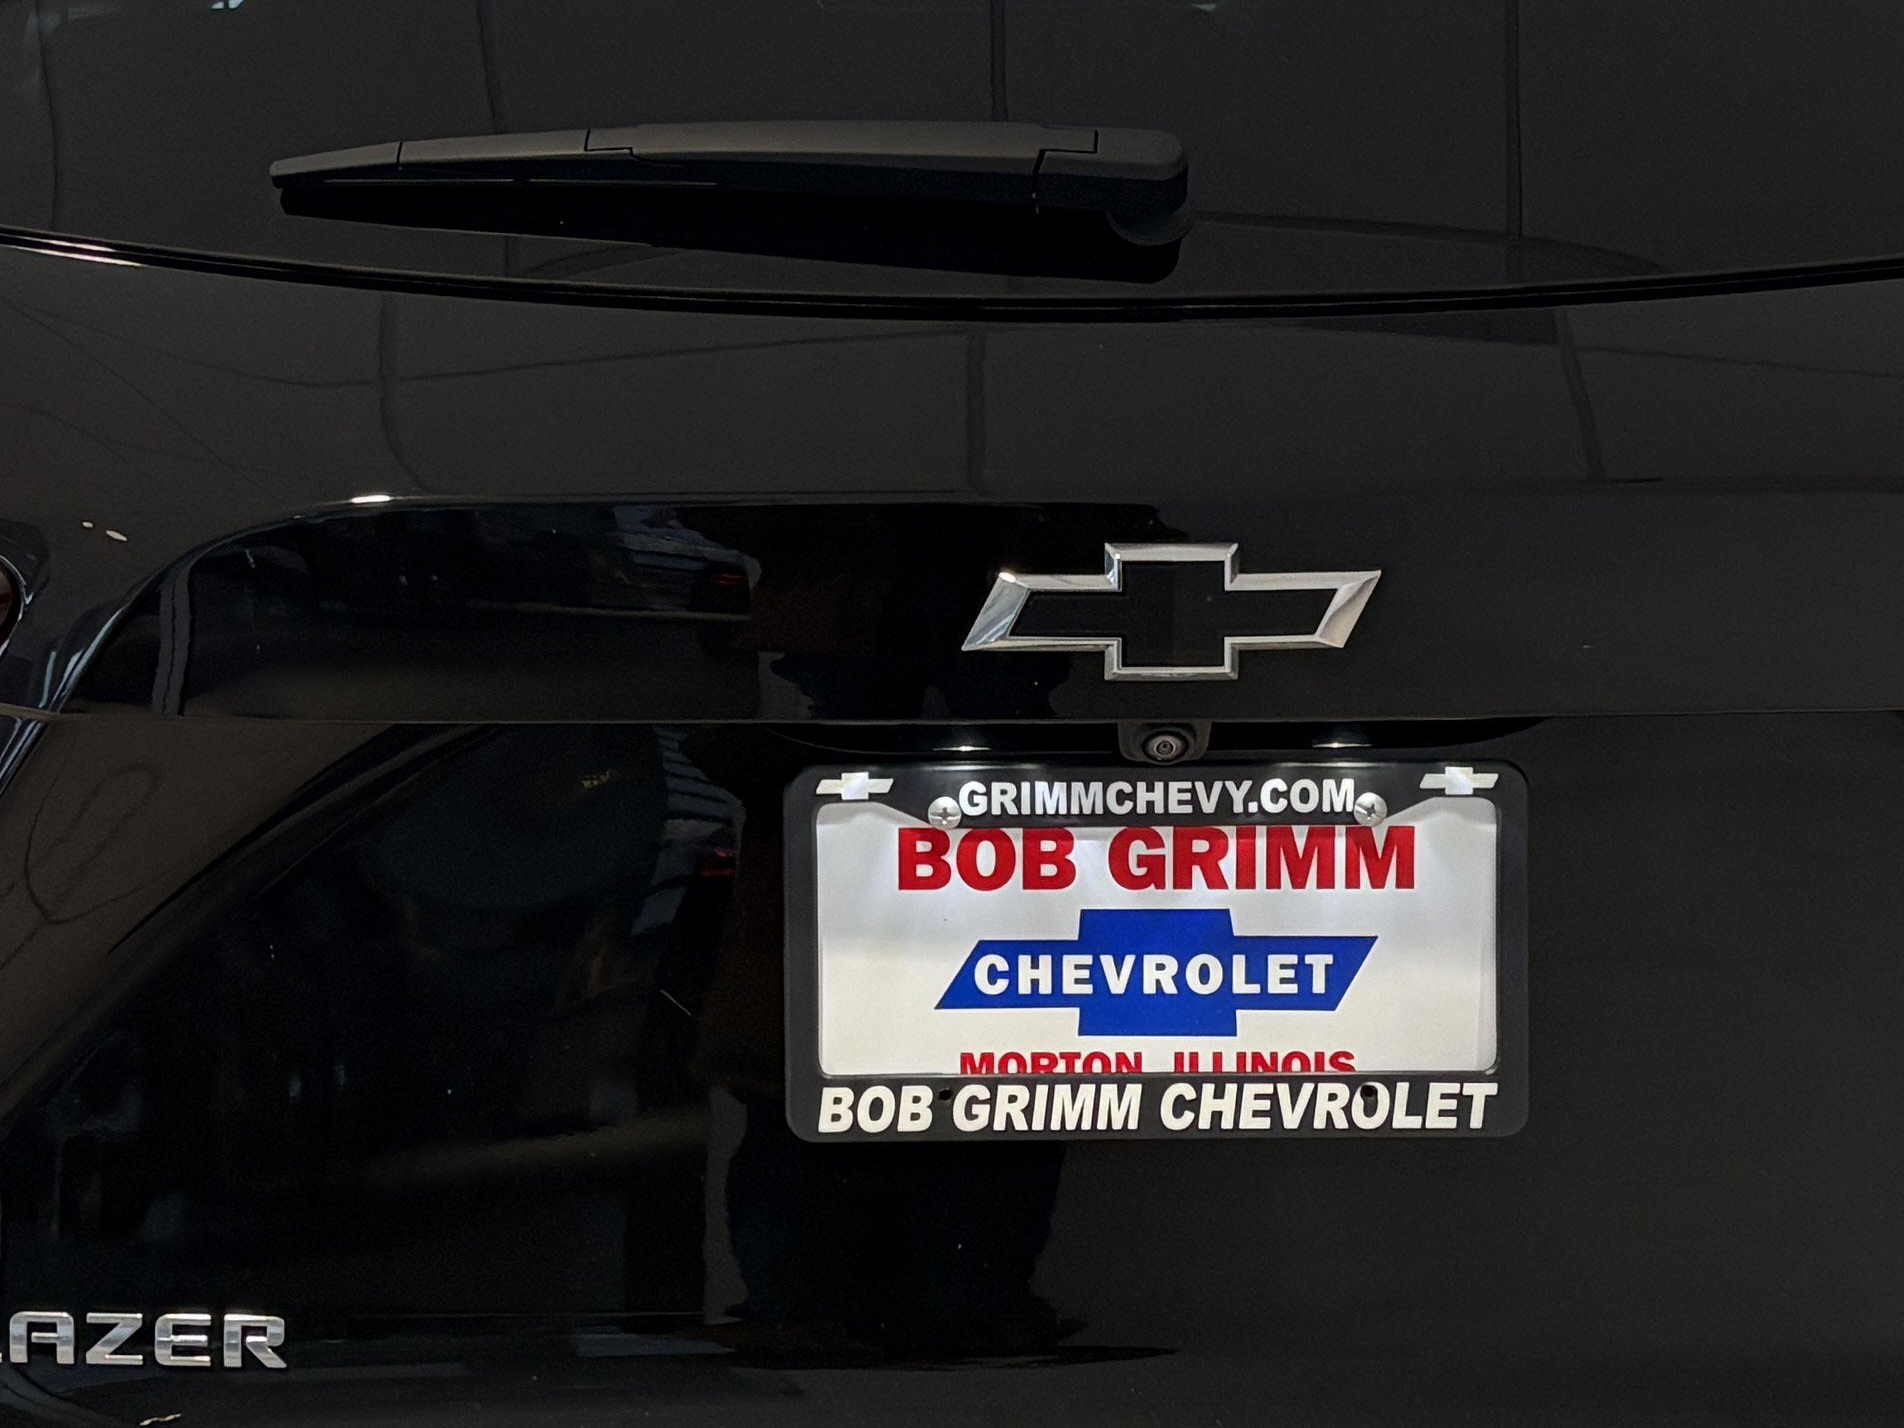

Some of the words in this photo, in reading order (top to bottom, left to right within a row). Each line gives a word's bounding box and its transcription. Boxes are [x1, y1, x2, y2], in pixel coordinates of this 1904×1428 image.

[958, 778, 1355, 817] GRIMMCHEVY.COM
[898, 826, 1076, 891] BOB
[1108, 825, 1415, 891] GRIMM
[973, 953, 1334, 996] CHEVROLET
[818, 1084, 934, 1133] BOB
[952, 1083, 1143, 1132] GRIMM
[1160, 1081, 1499, 1131] CHEVROLET
